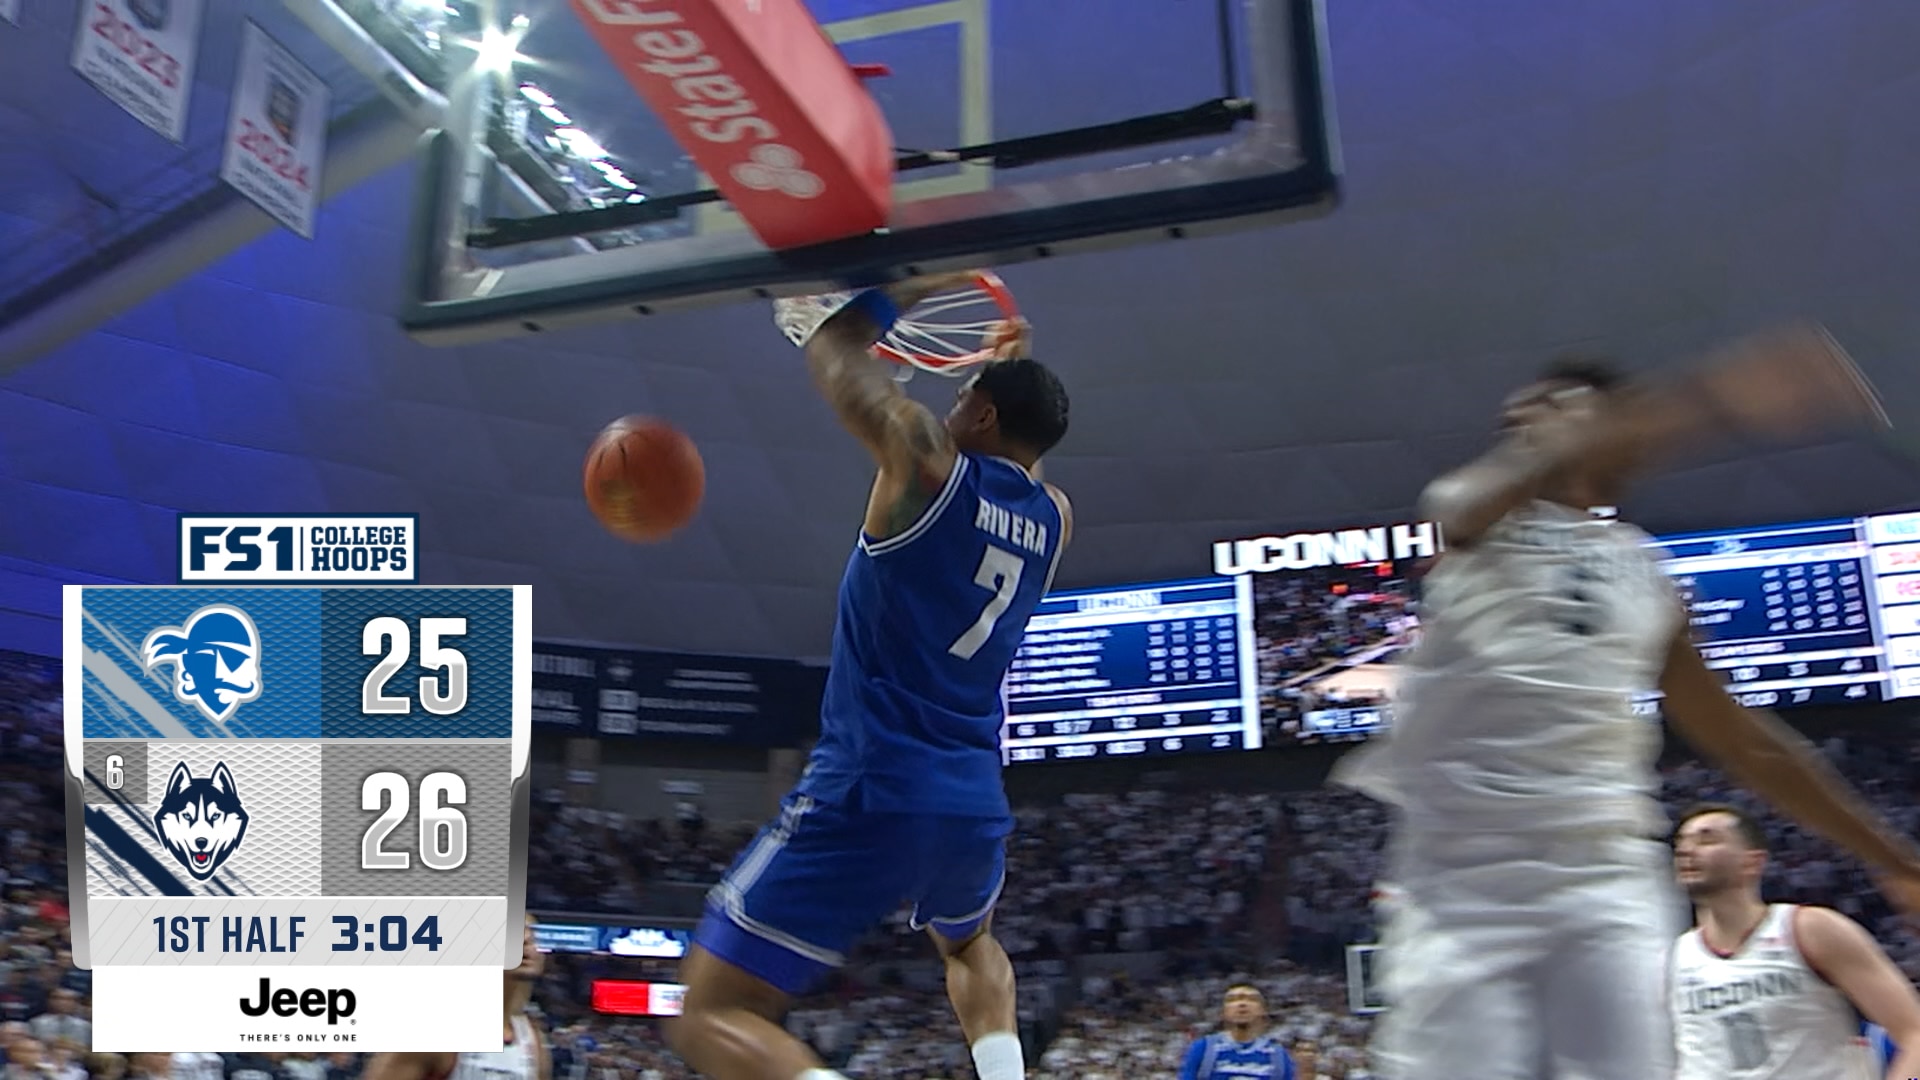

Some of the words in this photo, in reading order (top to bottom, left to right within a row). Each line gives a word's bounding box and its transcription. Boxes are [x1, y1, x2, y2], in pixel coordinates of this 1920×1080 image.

[581, 0, 780, 143] StateF
[974, 496, 1049, 558] RIVERA
[1213, 526, 1389, 575] UCONN
[948, 543, 1025, 661] 7
